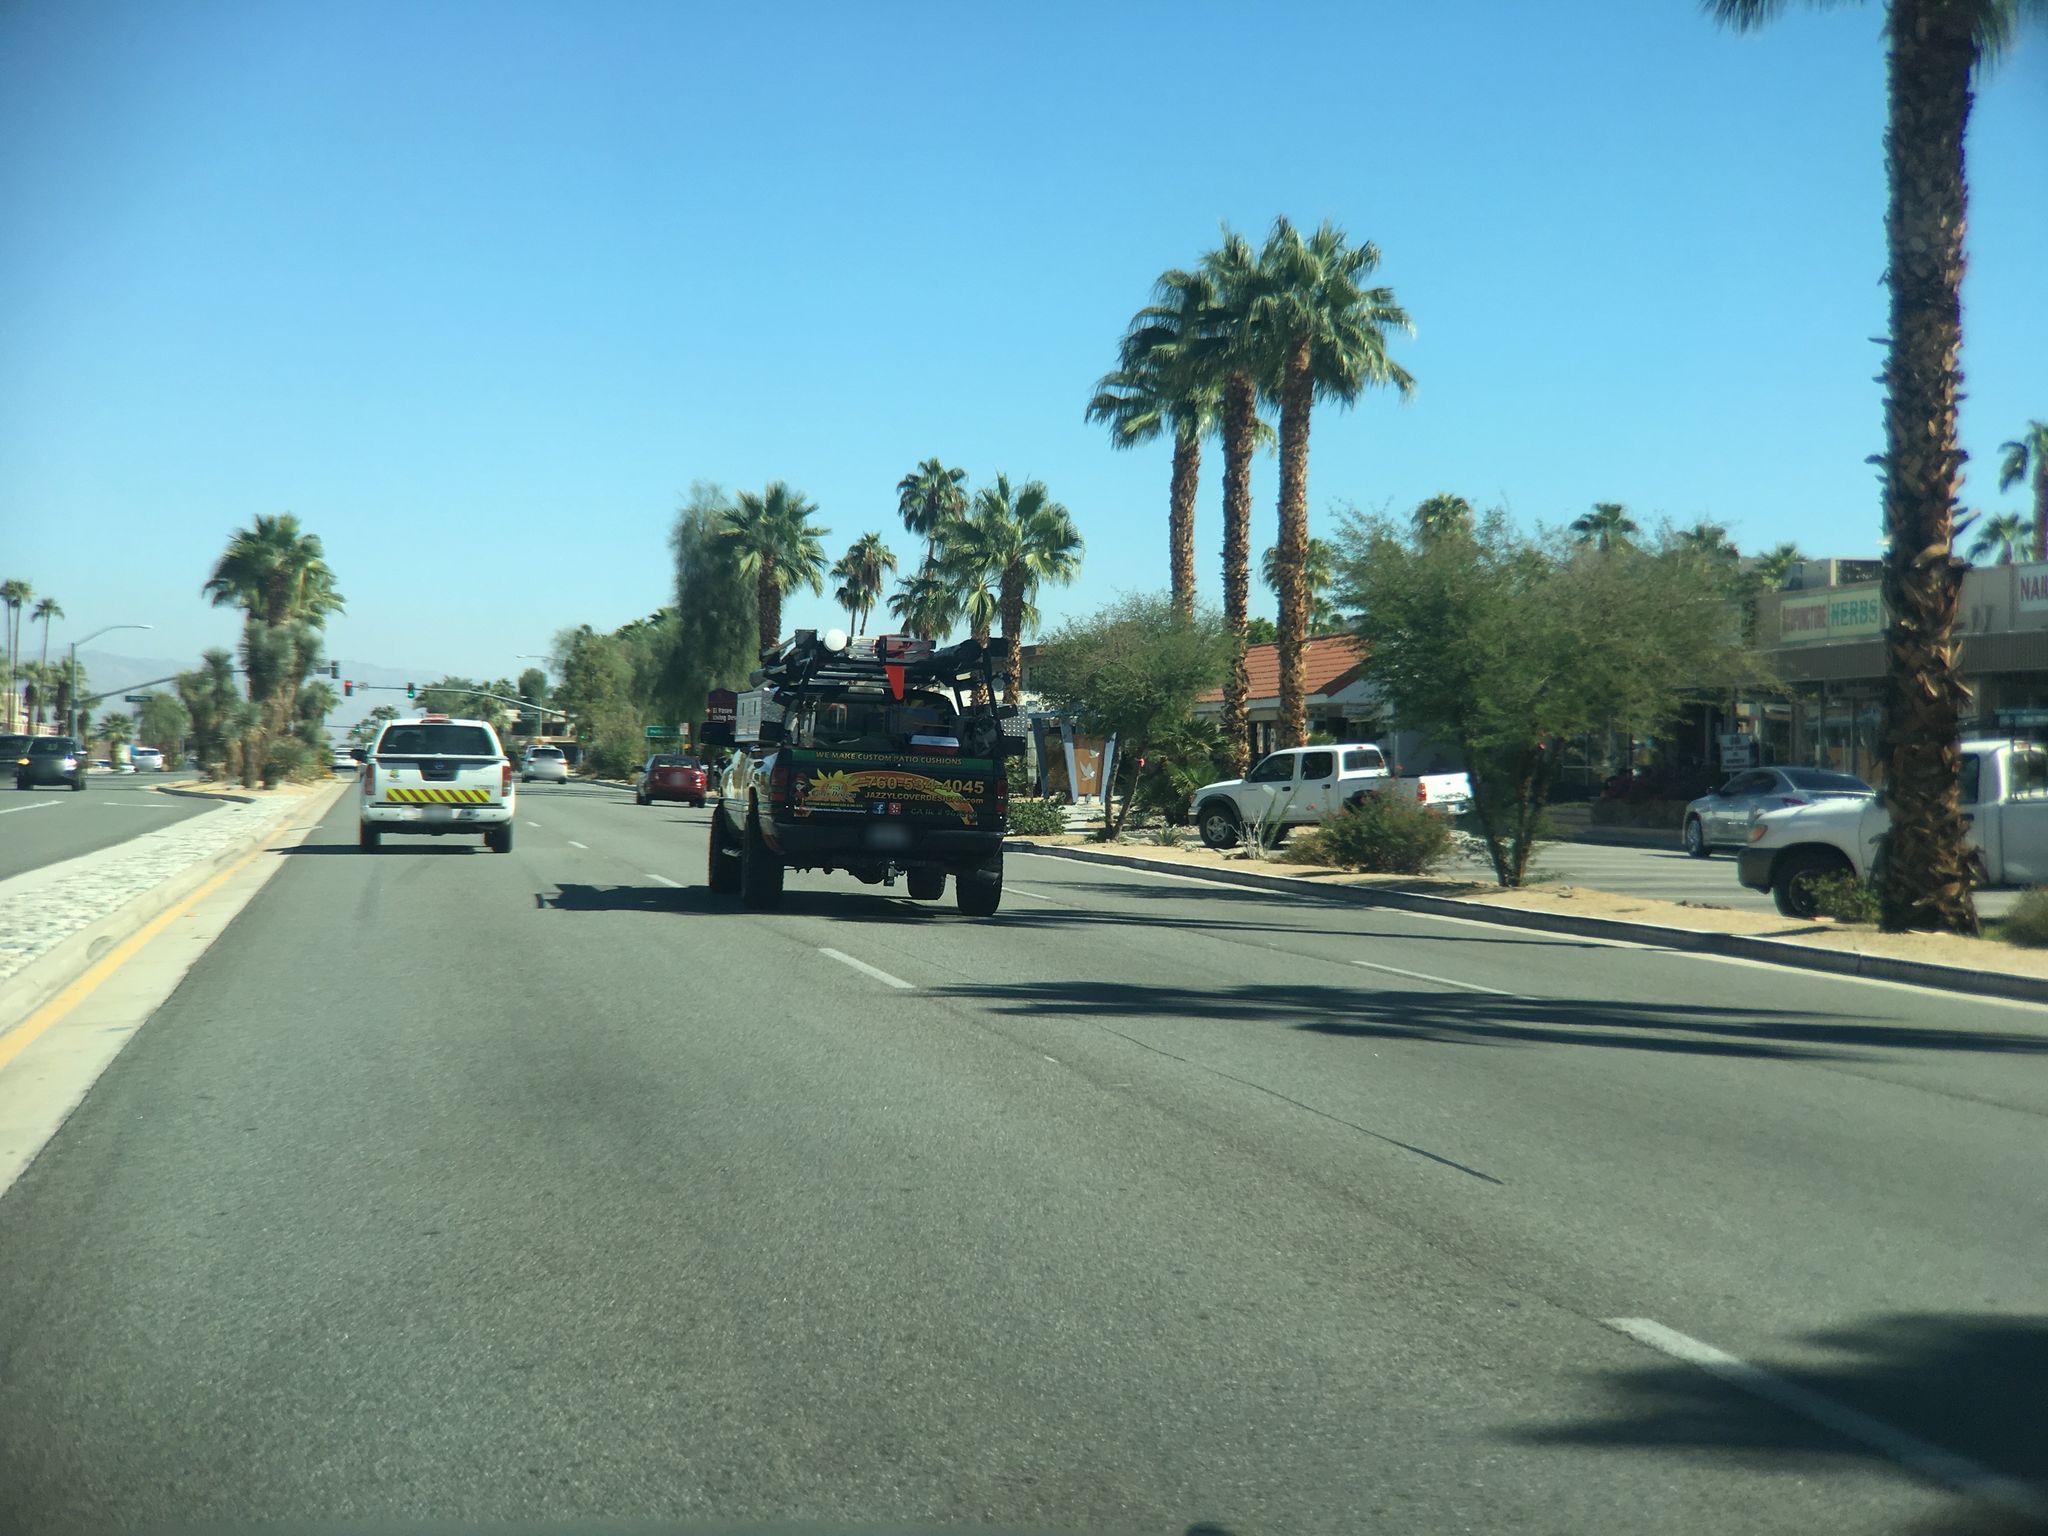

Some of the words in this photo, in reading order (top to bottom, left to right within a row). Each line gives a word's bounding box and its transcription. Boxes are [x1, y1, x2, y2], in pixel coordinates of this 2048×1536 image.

[1830, 599, 1878, 627] HERBS
[815, 751, 830, 759] WE
[831, 752, 856, 760] MAKE
[857, 753, 892, 762] CUSTOM
[893, 755, 919, 764] PATIO
[920, 757, 962, 766] CUSHIONS
[864, 775, 985, 794] 760-534-4045
[864, 791, 984, 805] JAZZYLCOVERDESIGNcom
